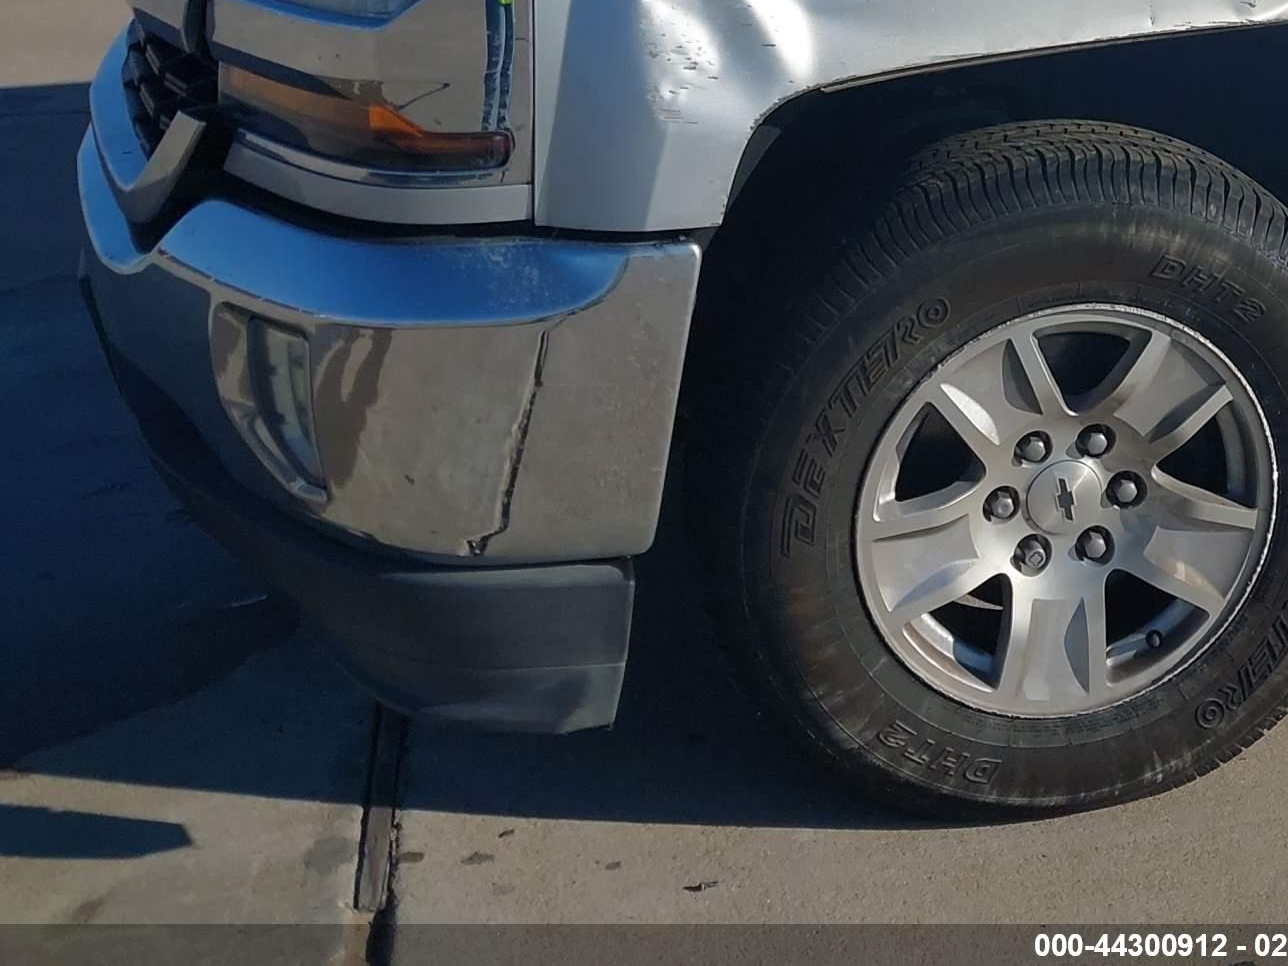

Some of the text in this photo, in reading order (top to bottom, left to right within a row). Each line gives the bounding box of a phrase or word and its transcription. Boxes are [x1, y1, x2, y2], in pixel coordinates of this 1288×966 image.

[1148, 251, 1267, 322] DHT2
[780, 297, 953, 558] DEXTERO
[878, 718, 1003, 785] DHT2
